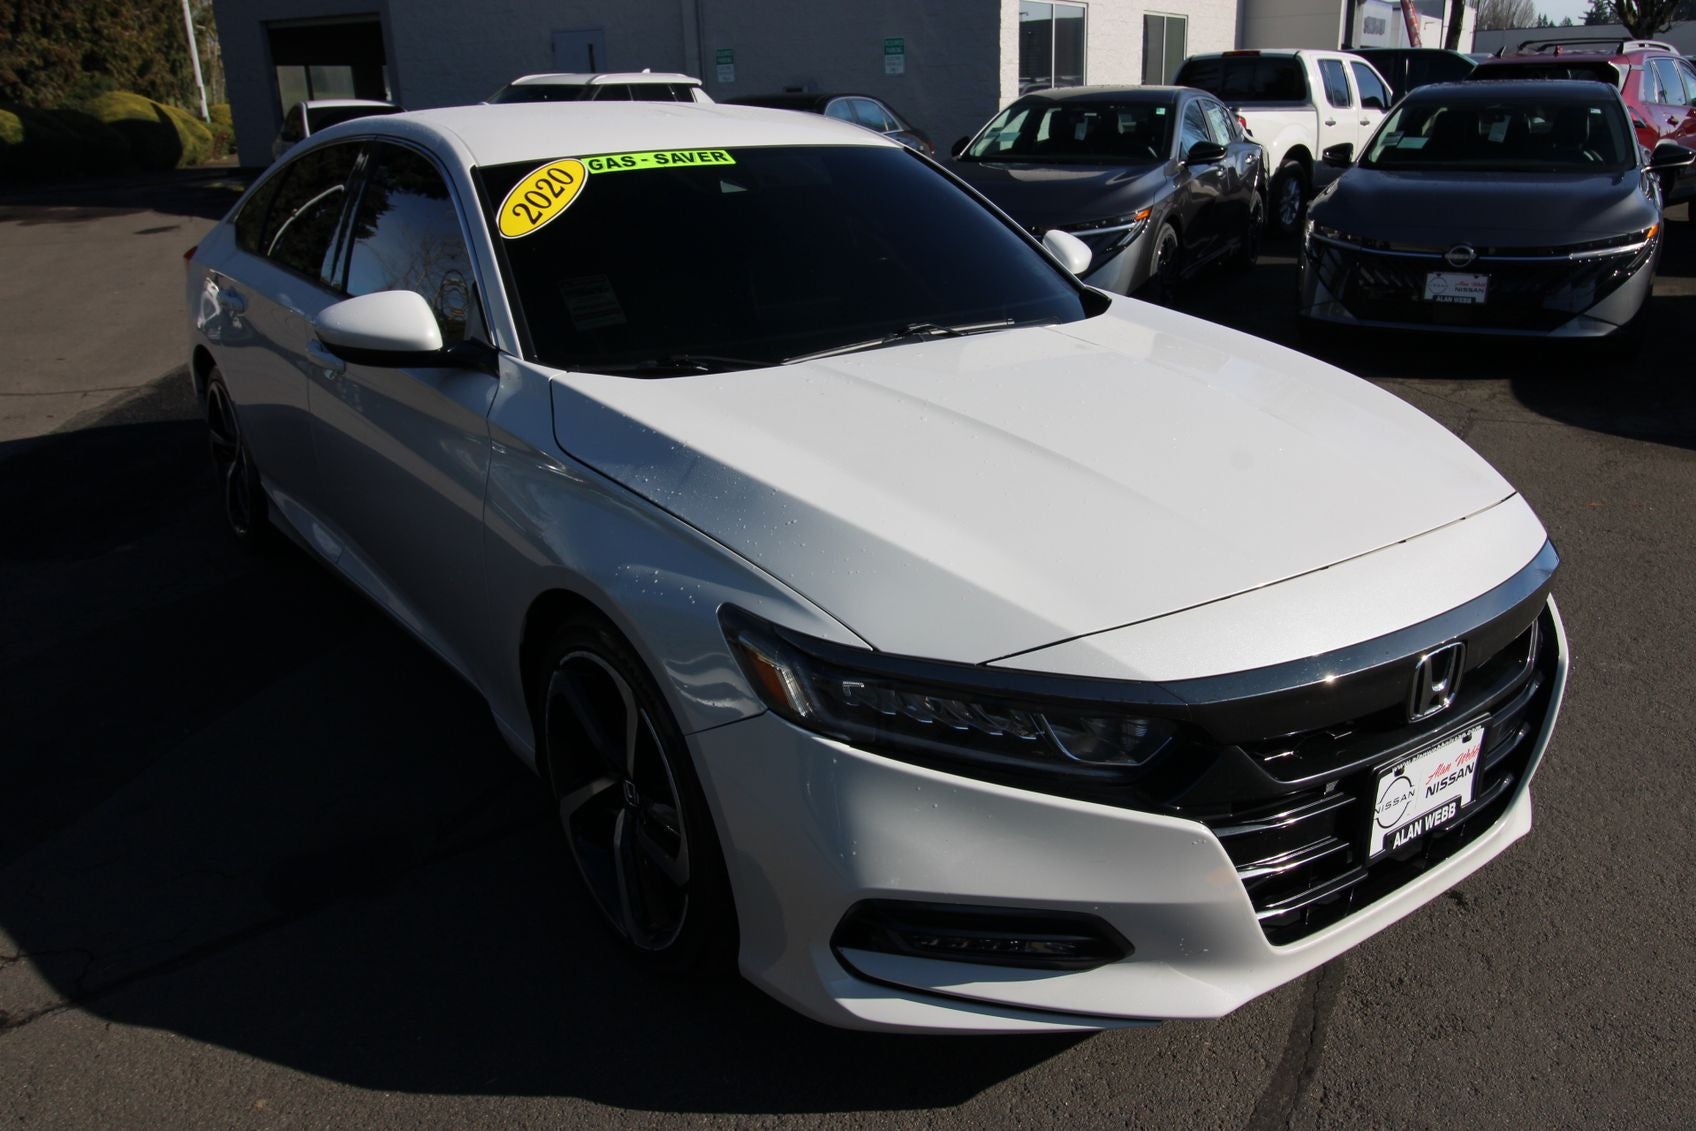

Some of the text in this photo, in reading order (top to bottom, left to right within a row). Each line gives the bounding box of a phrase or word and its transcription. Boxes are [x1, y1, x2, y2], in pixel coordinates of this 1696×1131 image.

[588, 155, 636, 171] GAS
[653, 151, 729, 165] SAVER
[512, 167, 574, 225] 2020
[1425, 762, 1475, 798] NISSAN
[1374, 789, 1415, 815] NISSAN
[1392, 802, 1456, 849] ALAN WEBB
